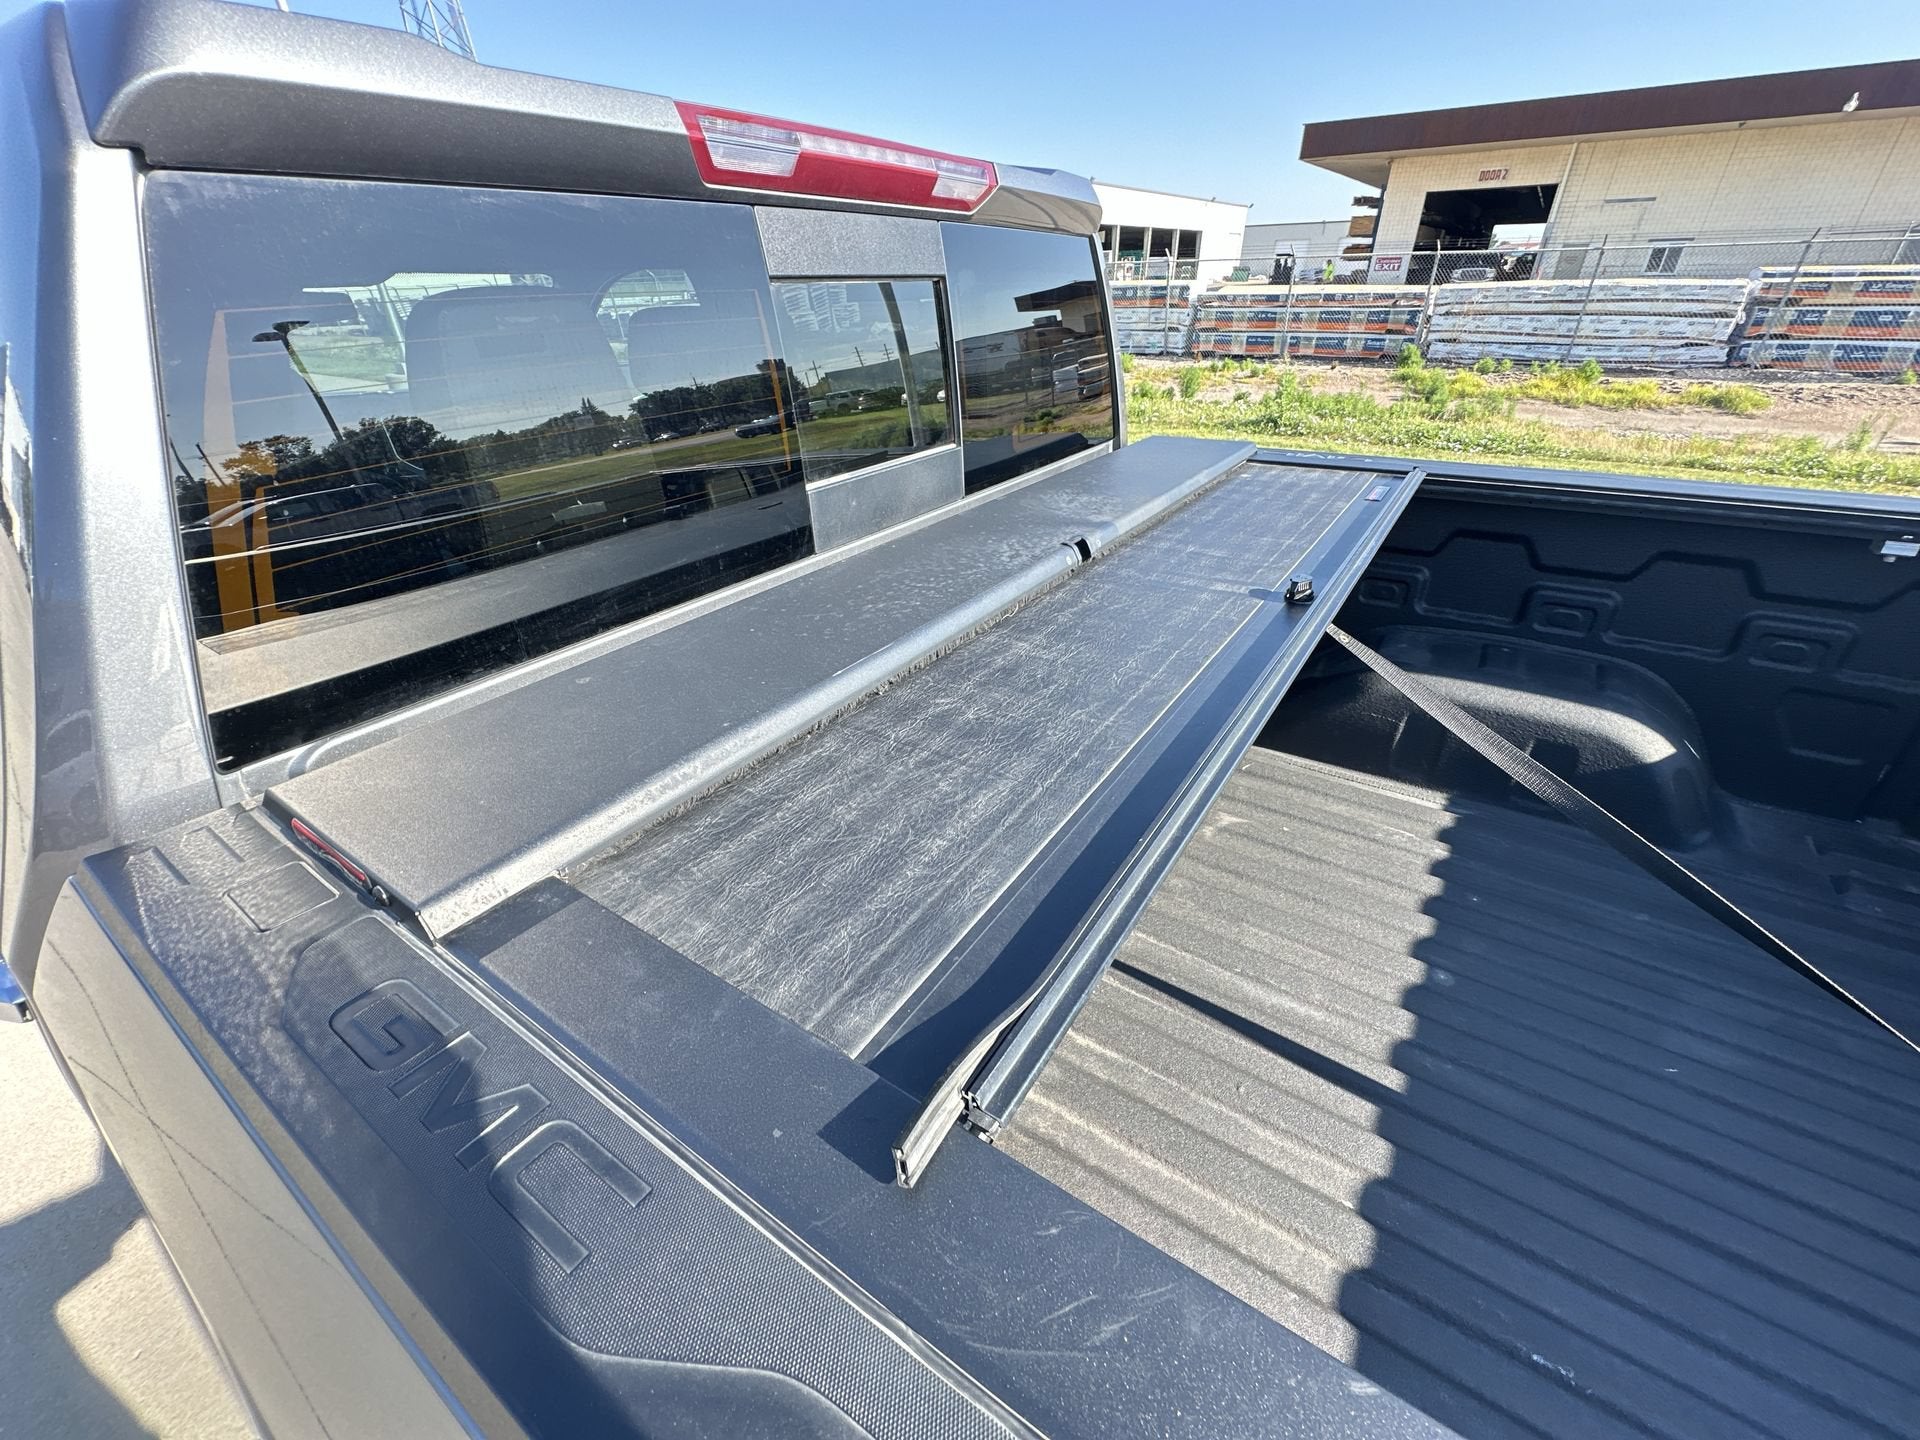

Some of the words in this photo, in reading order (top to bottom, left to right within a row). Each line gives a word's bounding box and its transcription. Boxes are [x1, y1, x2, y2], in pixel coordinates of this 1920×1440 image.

[1478, 169, 1502, 181] DOOR
[1502, 168, 1509, 180] 2
[328, 978, 654, 1275] GMC
